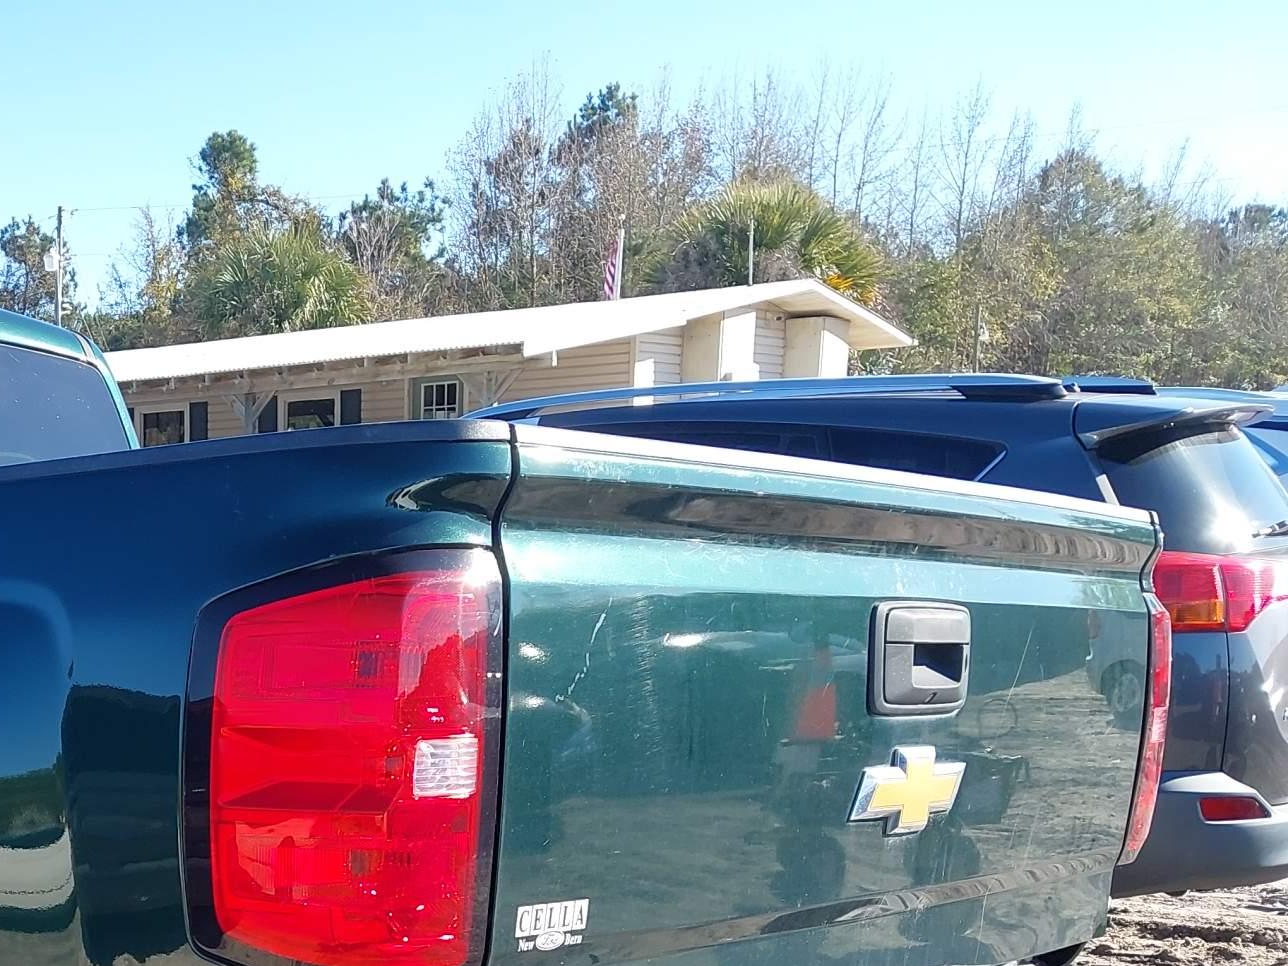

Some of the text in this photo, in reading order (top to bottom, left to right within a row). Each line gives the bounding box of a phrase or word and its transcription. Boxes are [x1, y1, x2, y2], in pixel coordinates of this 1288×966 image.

[518, 903, 584, 933] CELLA
[517, 938, 535, 953] New
[564, 933, 583, 946] Bern
